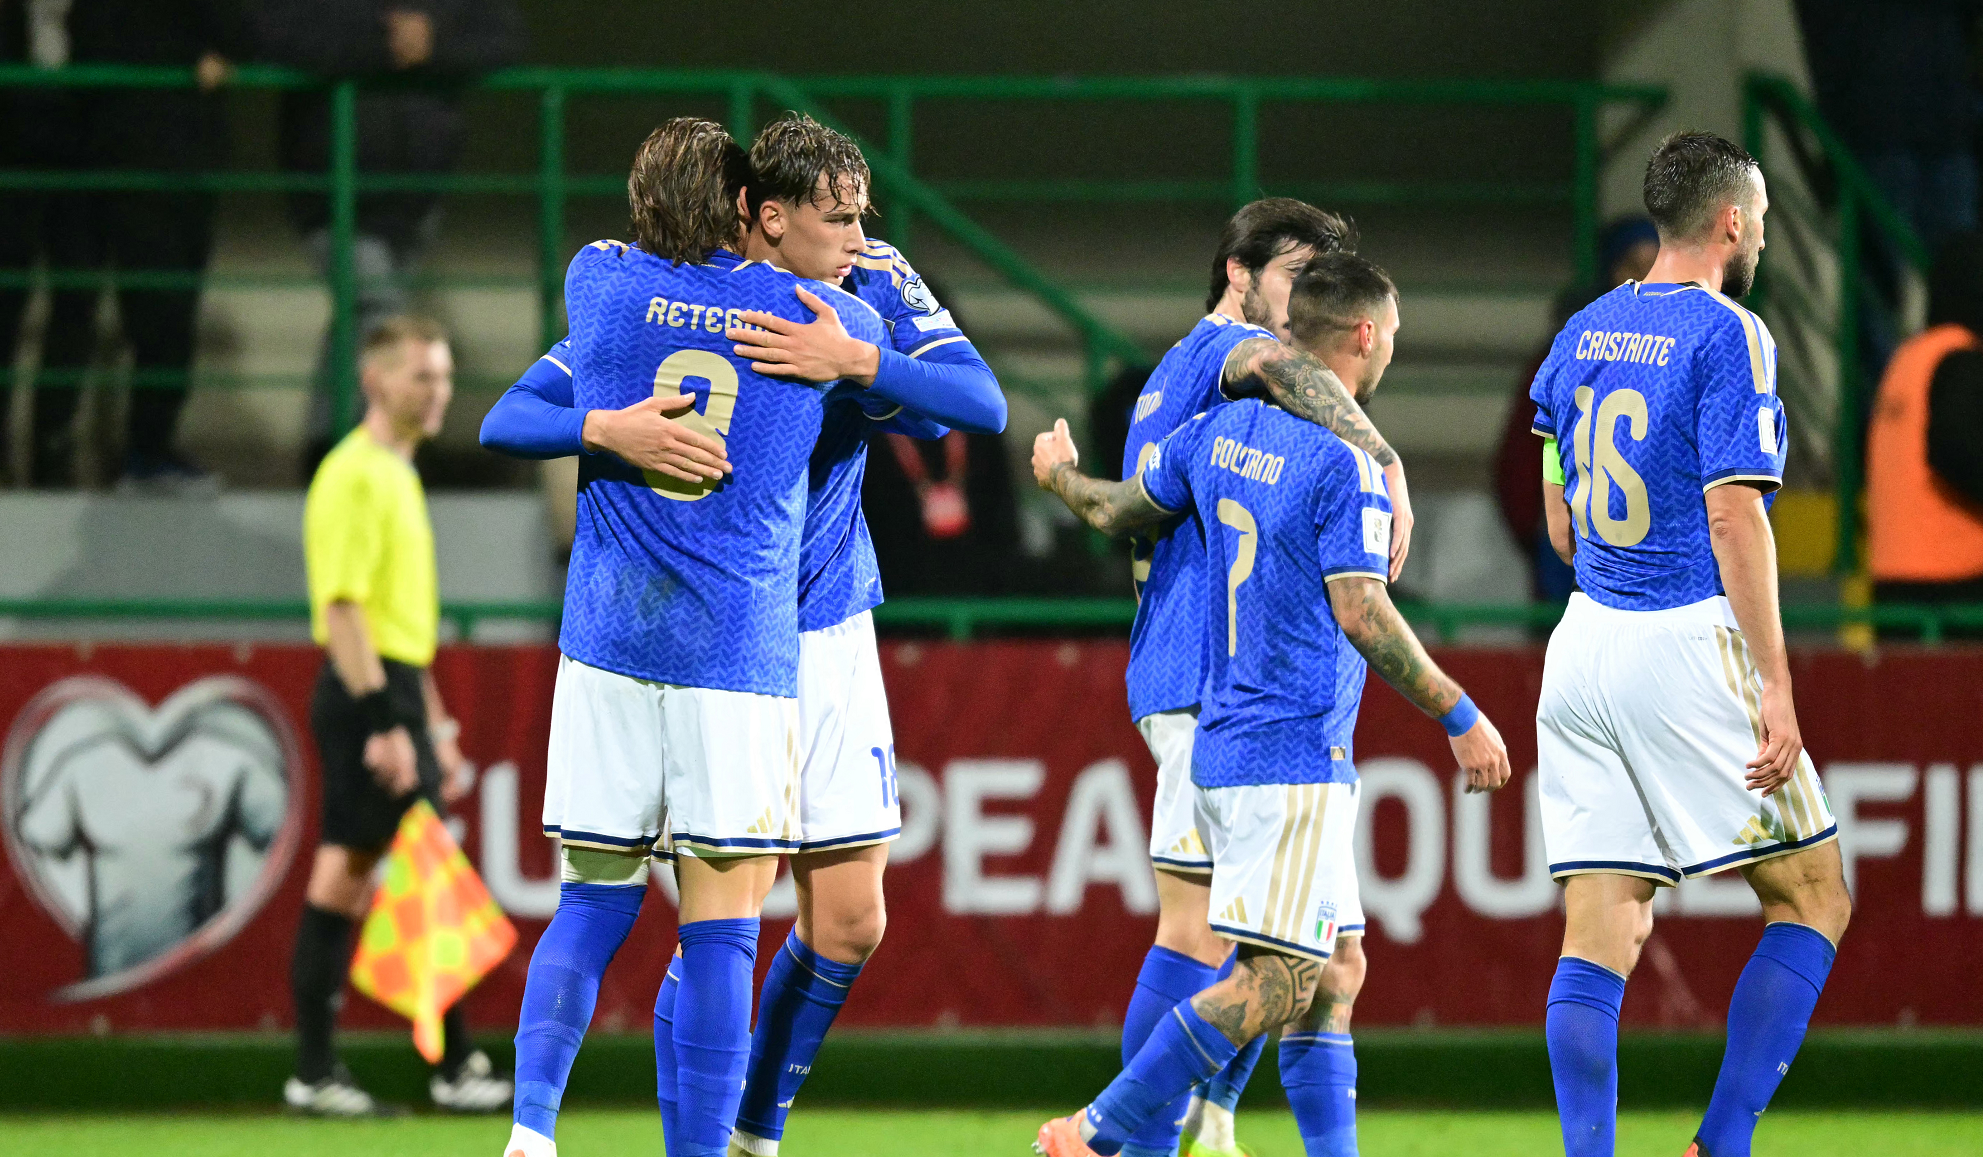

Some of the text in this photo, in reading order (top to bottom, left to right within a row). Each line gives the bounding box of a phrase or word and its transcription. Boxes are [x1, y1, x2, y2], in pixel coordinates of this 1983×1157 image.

[1575, 329, 1676, 367] CRISTANTE
[1571, 385, 1651, 547] 16
[1216, 497, 1258, 657] 7
